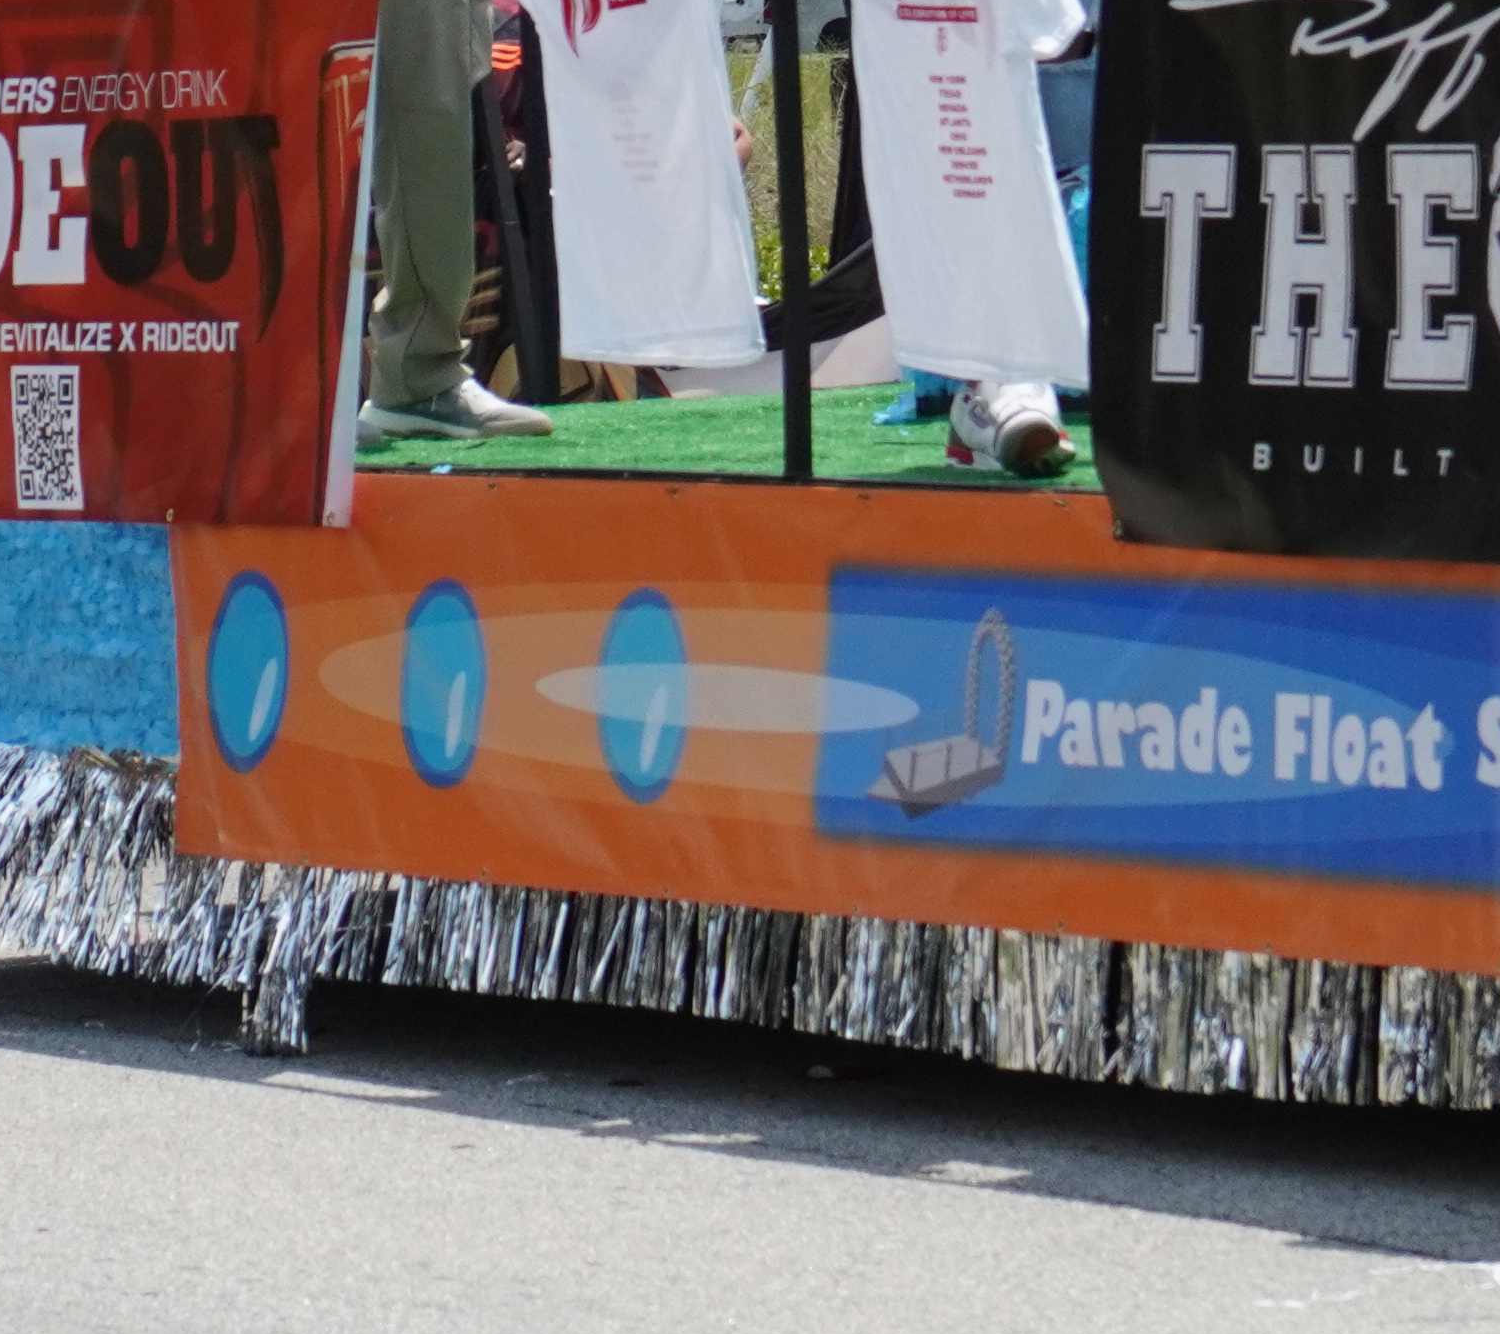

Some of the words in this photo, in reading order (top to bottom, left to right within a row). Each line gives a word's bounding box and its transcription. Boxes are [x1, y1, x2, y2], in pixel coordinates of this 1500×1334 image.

[60, 71, 154, 114] ENERGY
[160, 69, 228, 108] DRINK
[1139, 142, 1480, 392] THE
[118, 321, 136, 351] X
[142, 320, 239, 353] RIDEOUT
[1251, 442, 1454, 477] BUILT
[1020, 678, 1254, 777] Parade
[1272, 690, 1448, 793] Float
